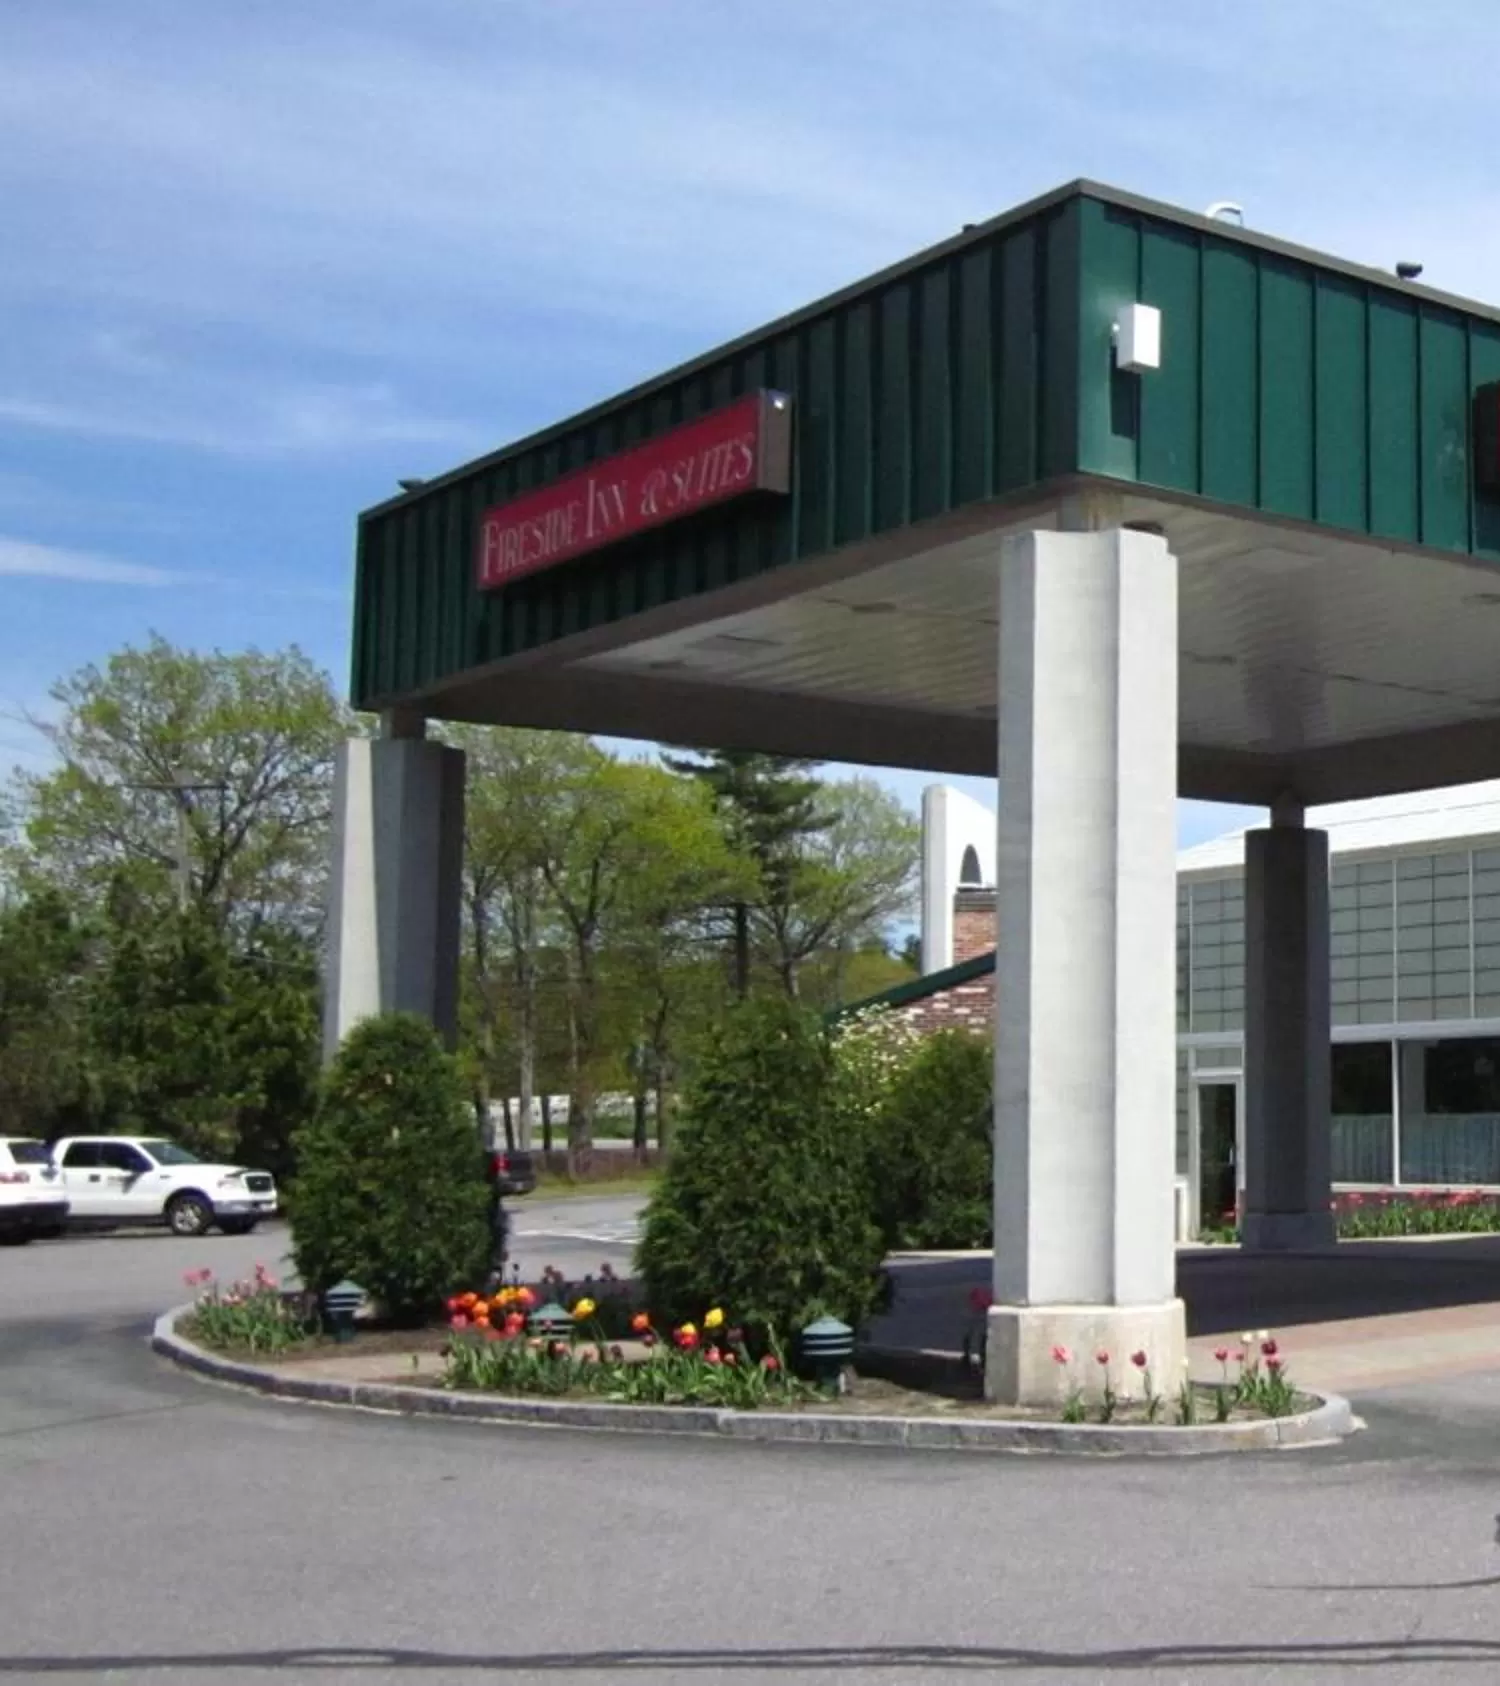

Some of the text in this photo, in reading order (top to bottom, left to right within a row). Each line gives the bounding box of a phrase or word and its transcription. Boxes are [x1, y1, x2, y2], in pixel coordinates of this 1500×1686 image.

[483, 434, 755, 579] FIRESIDE INN & SUITES
